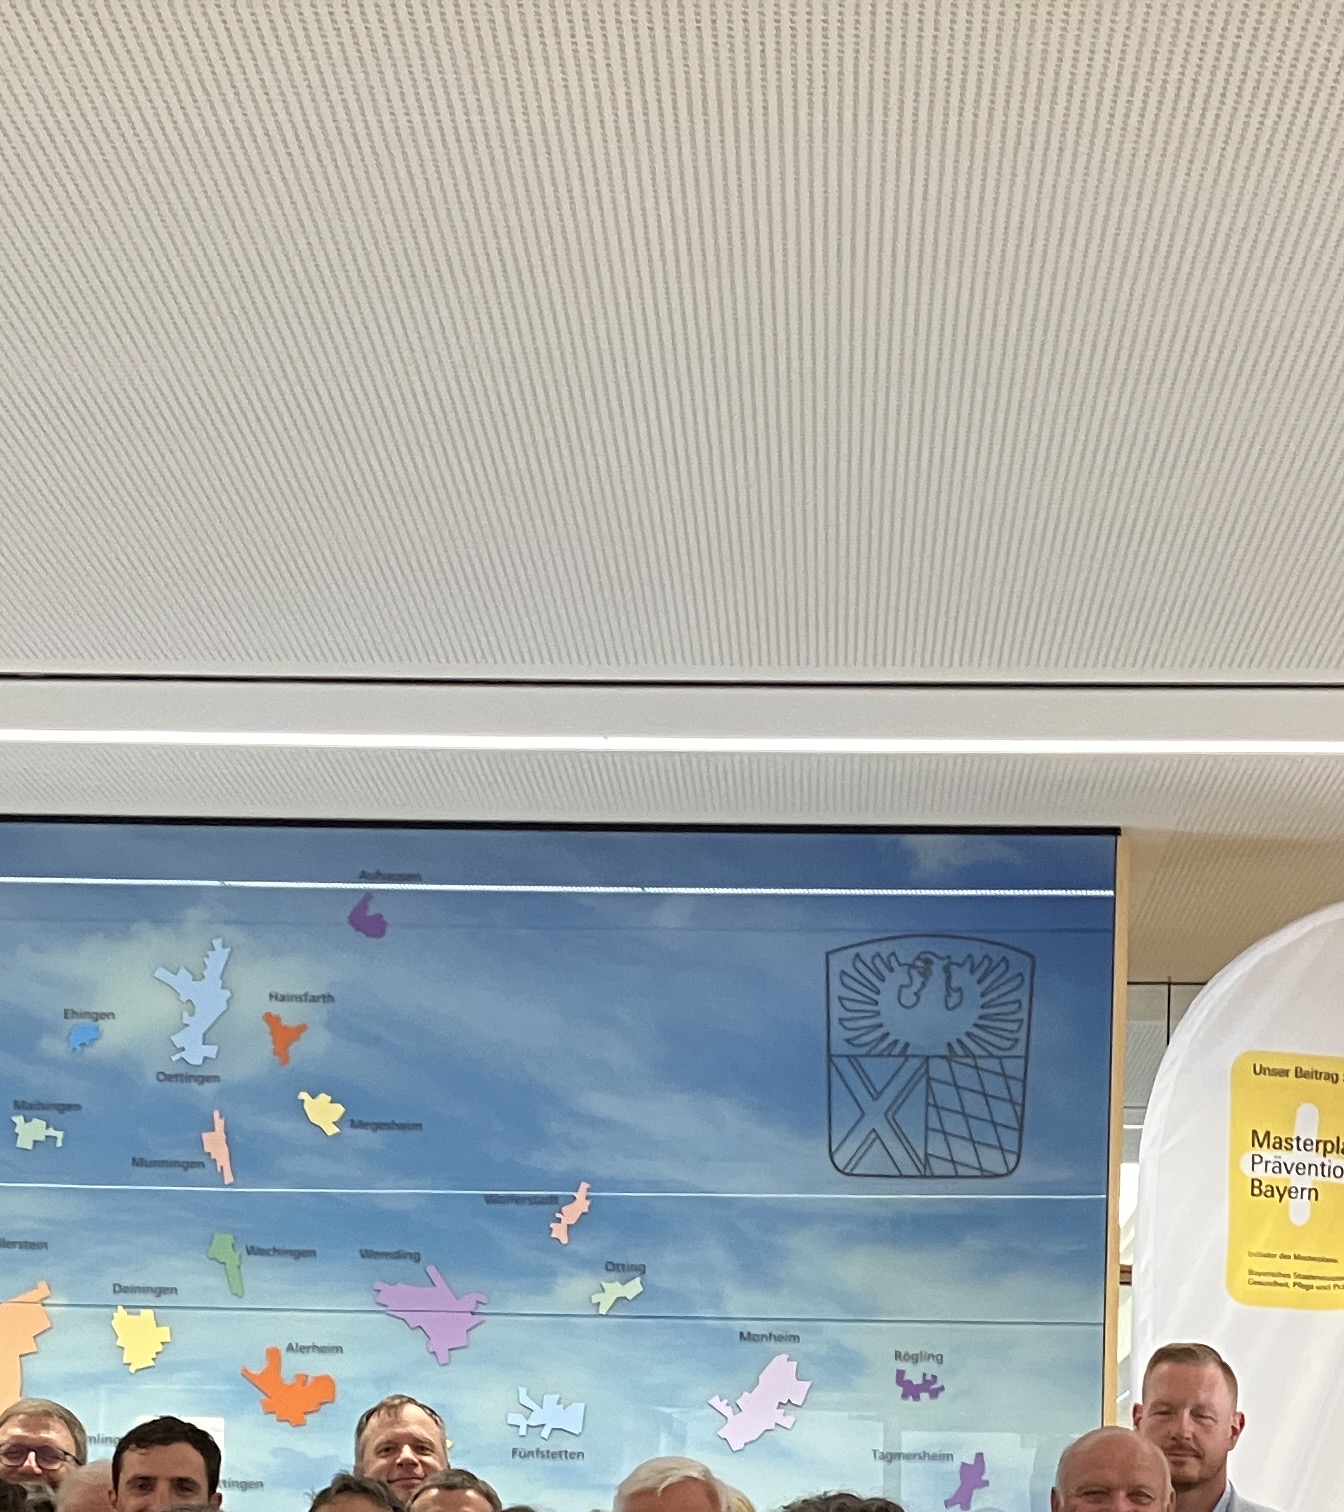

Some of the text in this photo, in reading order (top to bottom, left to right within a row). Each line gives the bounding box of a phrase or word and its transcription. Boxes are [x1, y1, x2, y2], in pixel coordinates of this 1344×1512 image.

[268, 990, 336, 1004] Hainsfarth
[63, 1008, 116, 1021] Ehingen
[1253, 1062, 1291, 1078] Unser
[1294, 1065, 1339, 1084] Beitrag
[1250, 1178, 1319, 1203] Bayern
[605, 1260, 646, 1276] Otting
[112, 1282, 179, 1298] Deiningen
[739, 1330, 801, 1344] Monheim
[285, 1342, 344, 1355] Alerheim
[894, 1349, 944, 1365] Rögling
[511, 1446, 585, 1461] Fünfstetten
[872, 1448, 955, 1464] Tagmersheim
